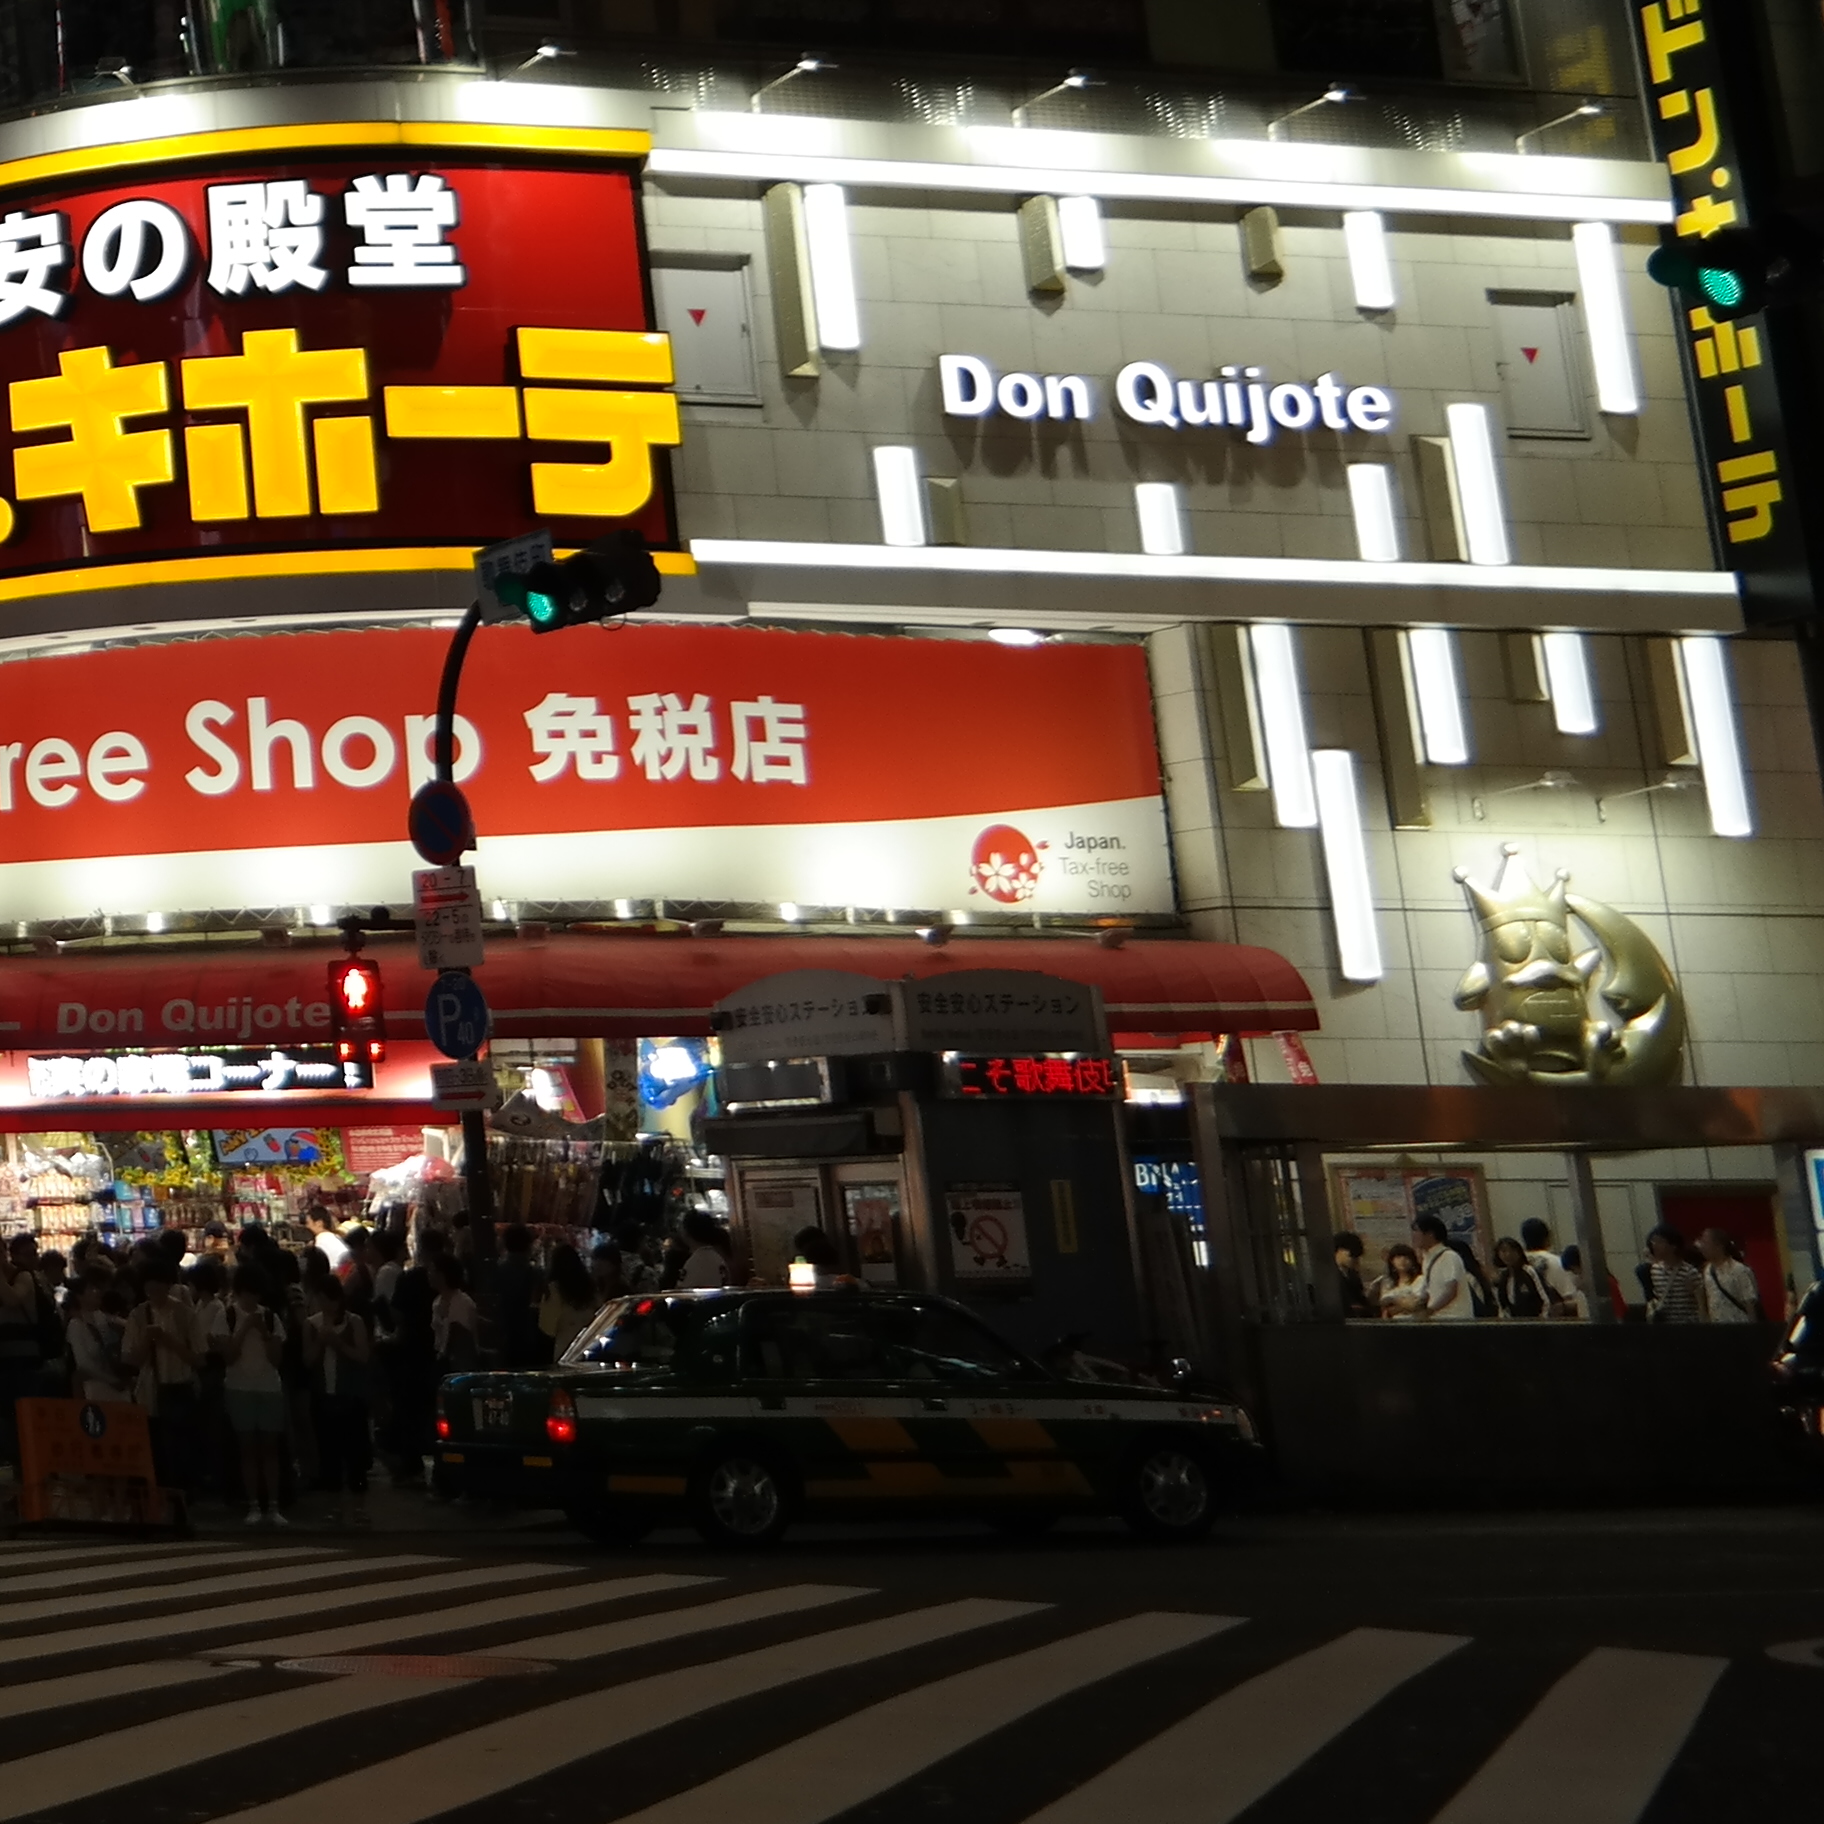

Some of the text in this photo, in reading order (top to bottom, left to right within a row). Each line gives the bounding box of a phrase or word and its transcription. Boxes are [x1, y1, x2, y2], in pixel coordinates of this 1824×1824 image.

[938, 354, 1394, 447] Don Quijote
[184, 696, 483, 798] Shop
[525, 690, 807, 787] 免税店
[1063, 832, 1127, 853] Japan.
[1060, 857, 1129, 880] Tax-free
[1087, 879, 1132, 903] Shop
[917, 991, 1079, 1016] 安全安心ステーション
[57, 995, 333, 1040] Don Quijote
